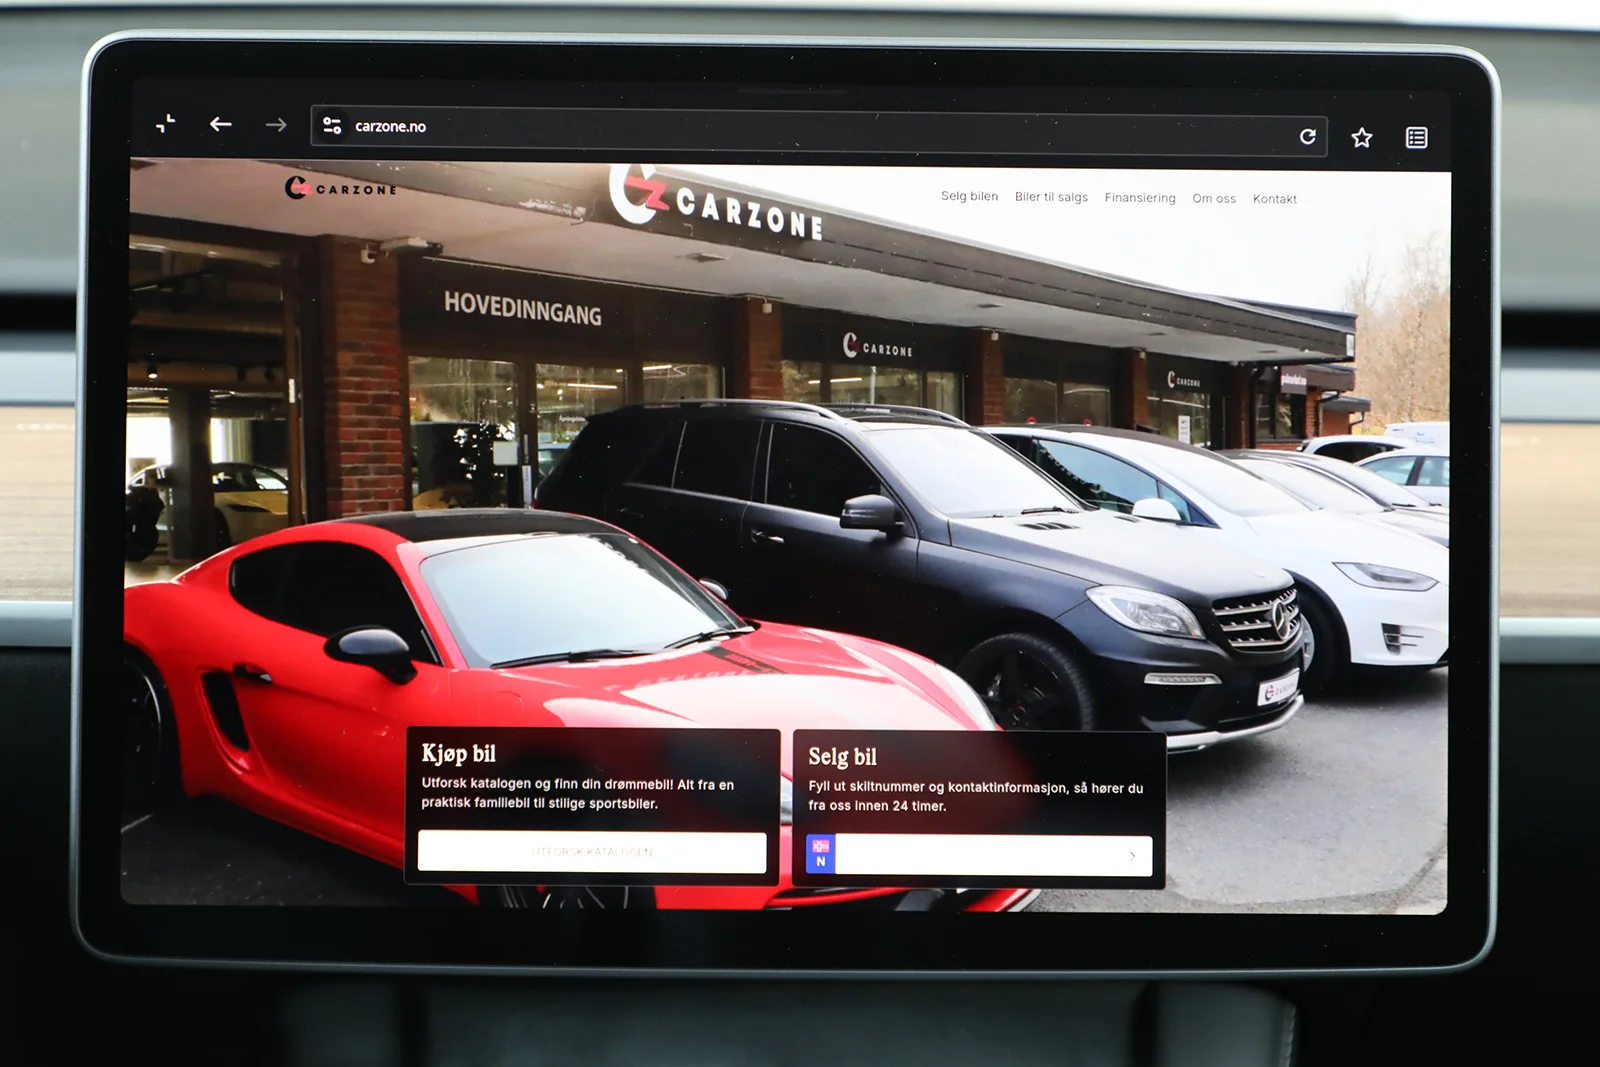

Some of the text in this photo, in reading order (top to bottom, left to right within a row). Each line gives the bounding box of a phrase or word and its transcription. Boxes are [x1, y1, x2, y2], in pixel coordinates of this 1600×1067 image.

[355, 121, 427, 133] carzone.no
[316, 185, 397, 195] CARZONE
[941, 189, 999, 204] Selg bilen
[1015, 191, 1089, 206] Biler til salgs
[1105, 191, 1177, 206] Finansiering
[1193, 193, 1237, 204] Om oss
[1254, 193, 1298, 205] Kontakt
[676, 187, 823, 240] CARZONE
[444, 290, 603, 327] HOVEDINNGANG
[863, 343, 913, 357] CARZONE
[421, 742, 497, 767] Kjøp bil
[808, 746, 878, 770] Selg bil
[422, 777, 735, 793] Utforsk katalogen og finn din drømmebil! Alt fra en
[808, 780, 1144, 796] Fyll ut skiltnummer og kontaktinformasjon, så hører du
[421, 796, 659, 812] praktisk familiebil til stilige sportsbiler.
[808, 799, 948, 812] fra oss innen 24 timer.
[816, 855, 826, 867] N
